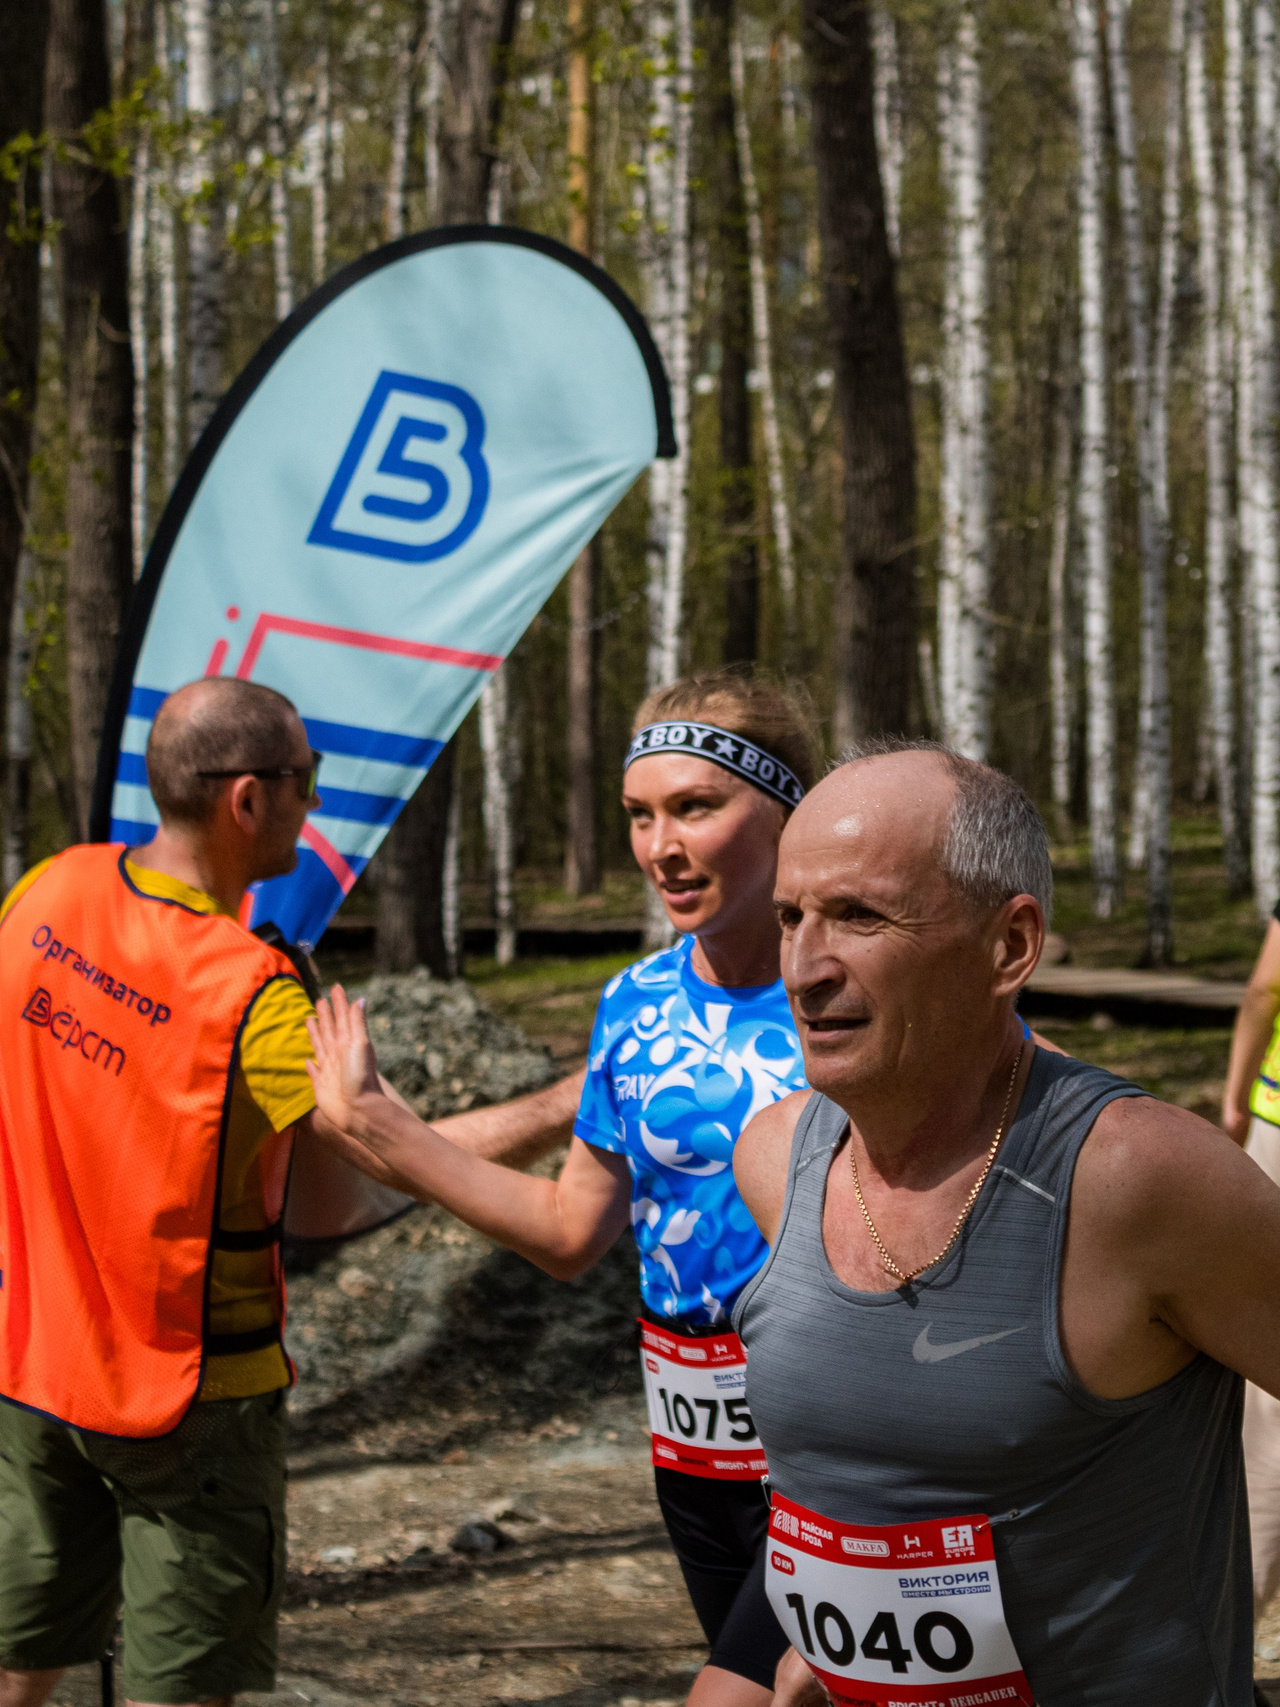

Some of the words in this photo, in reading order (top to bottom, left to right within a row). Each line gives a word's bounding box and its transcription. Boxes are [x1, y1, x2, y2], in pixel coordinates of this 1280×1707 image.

[648, 726, 713, 748] BOY
[738, 747, 792, 791] BOY
[32, 925, 172, 1027] Организатор
[659, 1388, 757, 1443] 1075
[801, 1520, 833, 1541] МАЙСКАЯ
[801, 1532, 822, 1548] ГРОЗА
[846, 1541, 885, 1554] MAKFA
[897, 1551, 934, 1560] HARPER
[944, 1546, 974, 1554] EUROPE
[898, 1571, 990, 1588] ВИКТОРИЯ
[954, 1585, 990, 1595] строим
[785, 1592, 974, 1674] 1040
